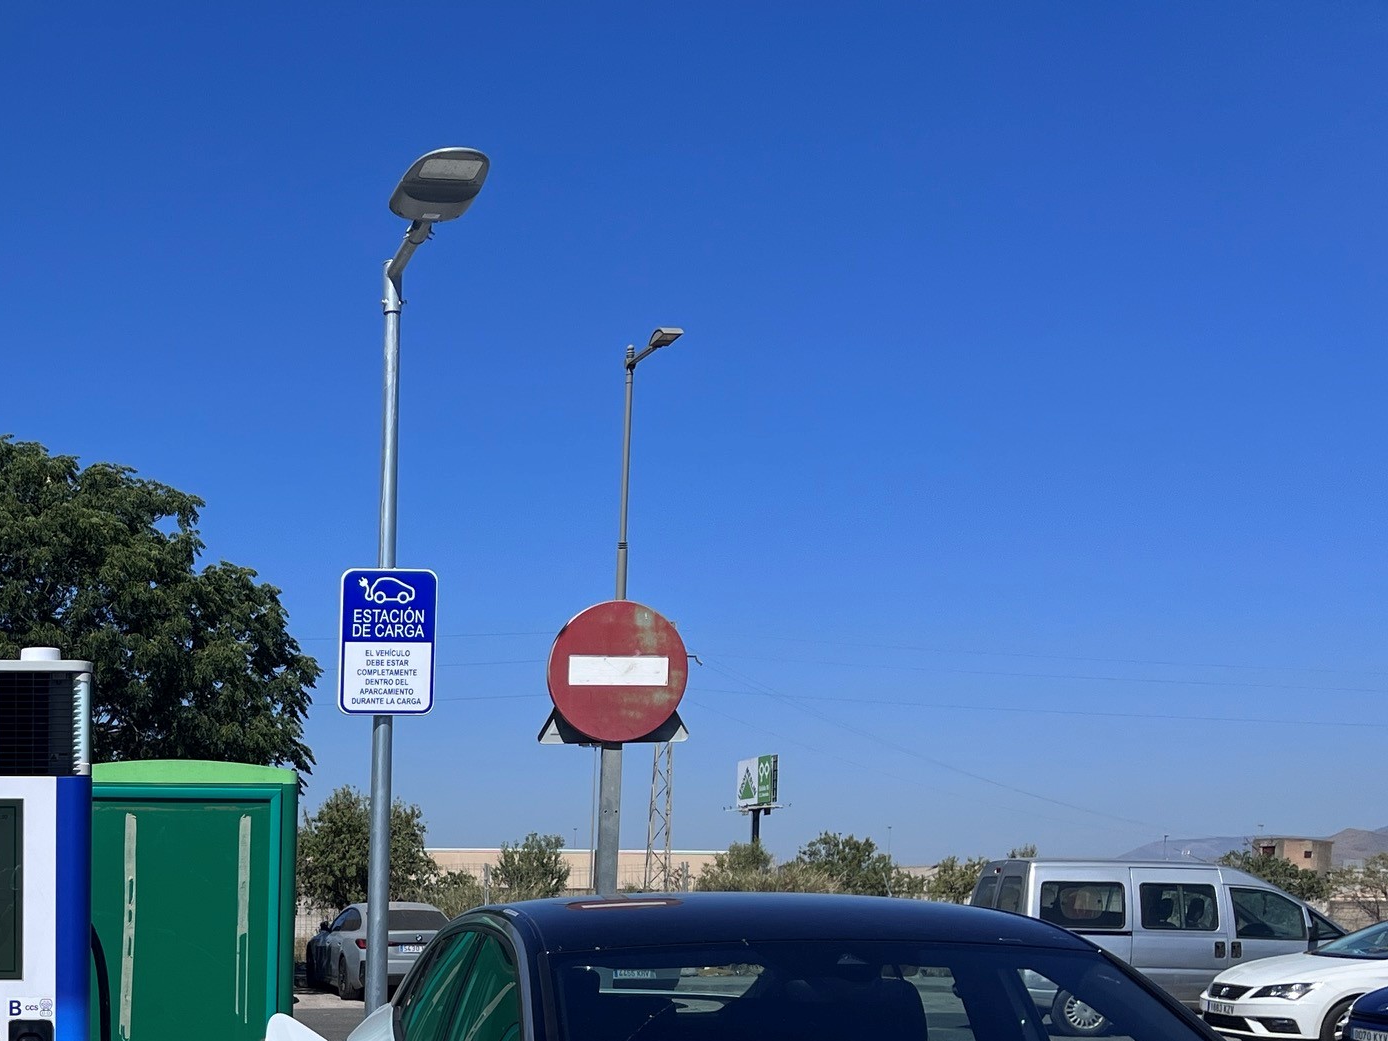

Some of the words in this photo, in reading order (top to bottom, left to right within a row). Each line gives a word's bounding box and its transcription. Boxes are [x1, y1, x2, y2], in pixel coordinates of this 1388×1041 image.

[353, 607, 425, 623] ESTACIÓN
[352, 624, 371, 637] DE
[374, 624, 424, 638] CARGA
[365, 649, 374, 657] EL
[375, 648, 411, 657] VEHÍCULO
[366, 659, 385, 667] DEBE
[386, 659, 409, 667] ESTAR
[359, 688, 414, 696] APARCAMIENTO
[351, 697, 384, 705] DURANTE
[9, 1000, 22, 1016] B
